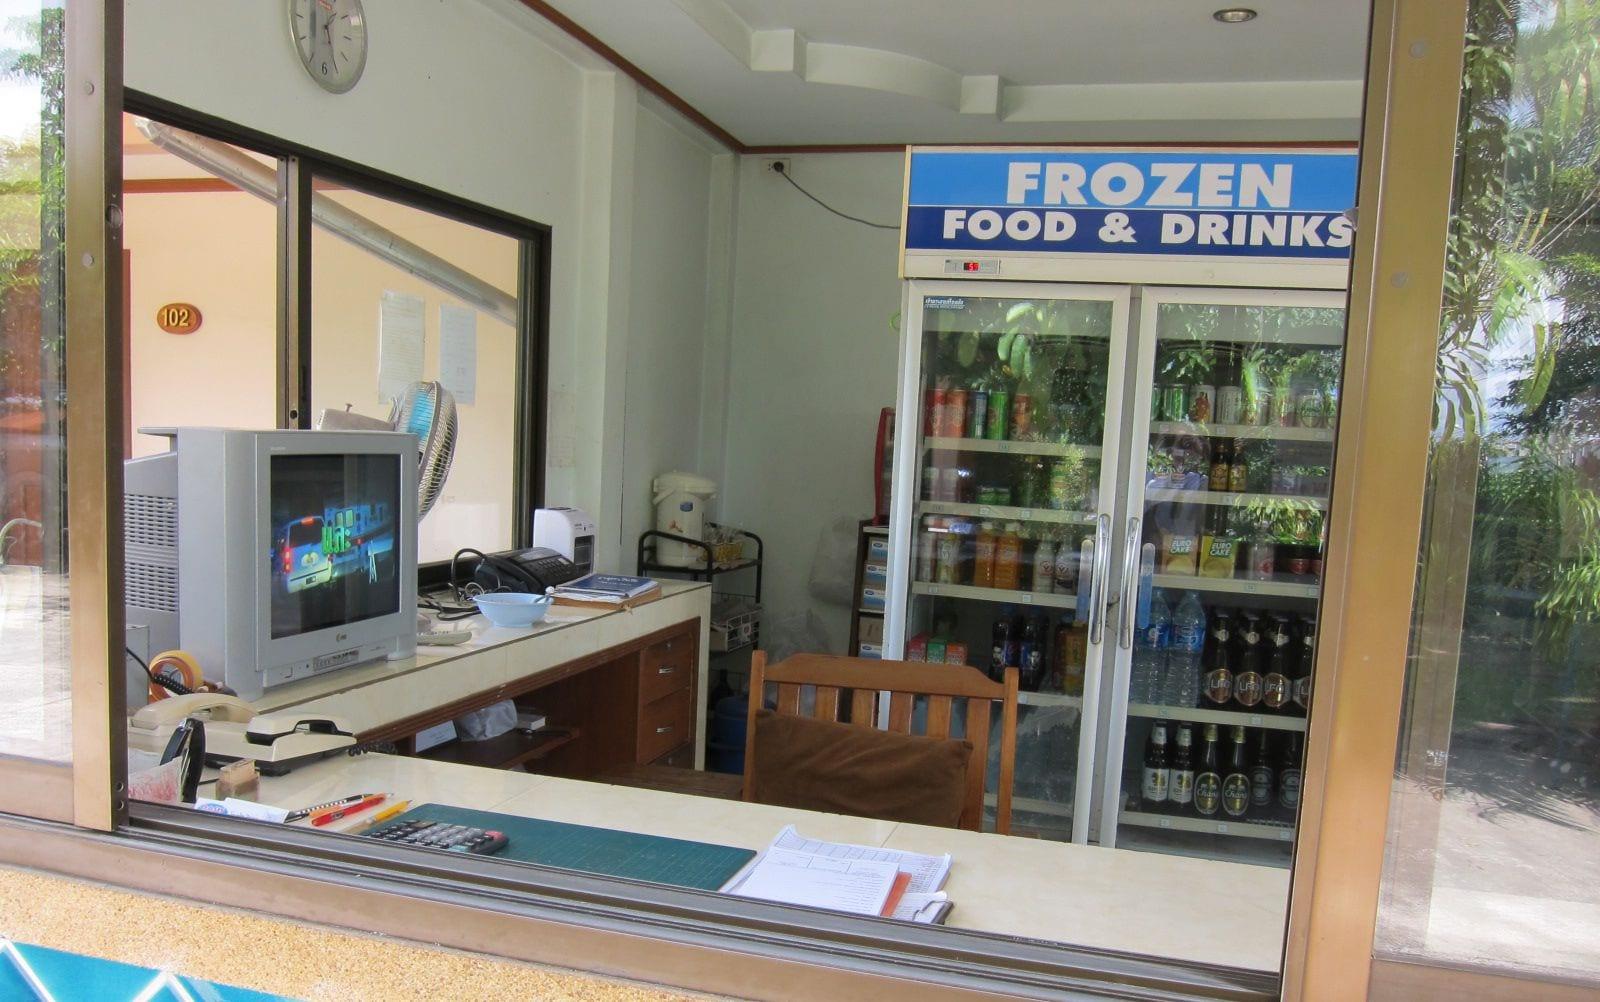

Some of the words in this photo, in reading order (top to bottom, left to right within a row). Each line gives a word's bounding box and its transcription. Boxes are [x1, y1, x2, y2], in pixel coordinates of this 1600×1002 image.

[321, 62, 328, 76] 6
[1006, 162, 1294, 208] FROZEN
[943, 209, 1077, 241] FOOD
[1098, 212, 1137, 243] &
[1161, 213, 1352, 247] DRINKS
[163, 308, 189, 327] 102
